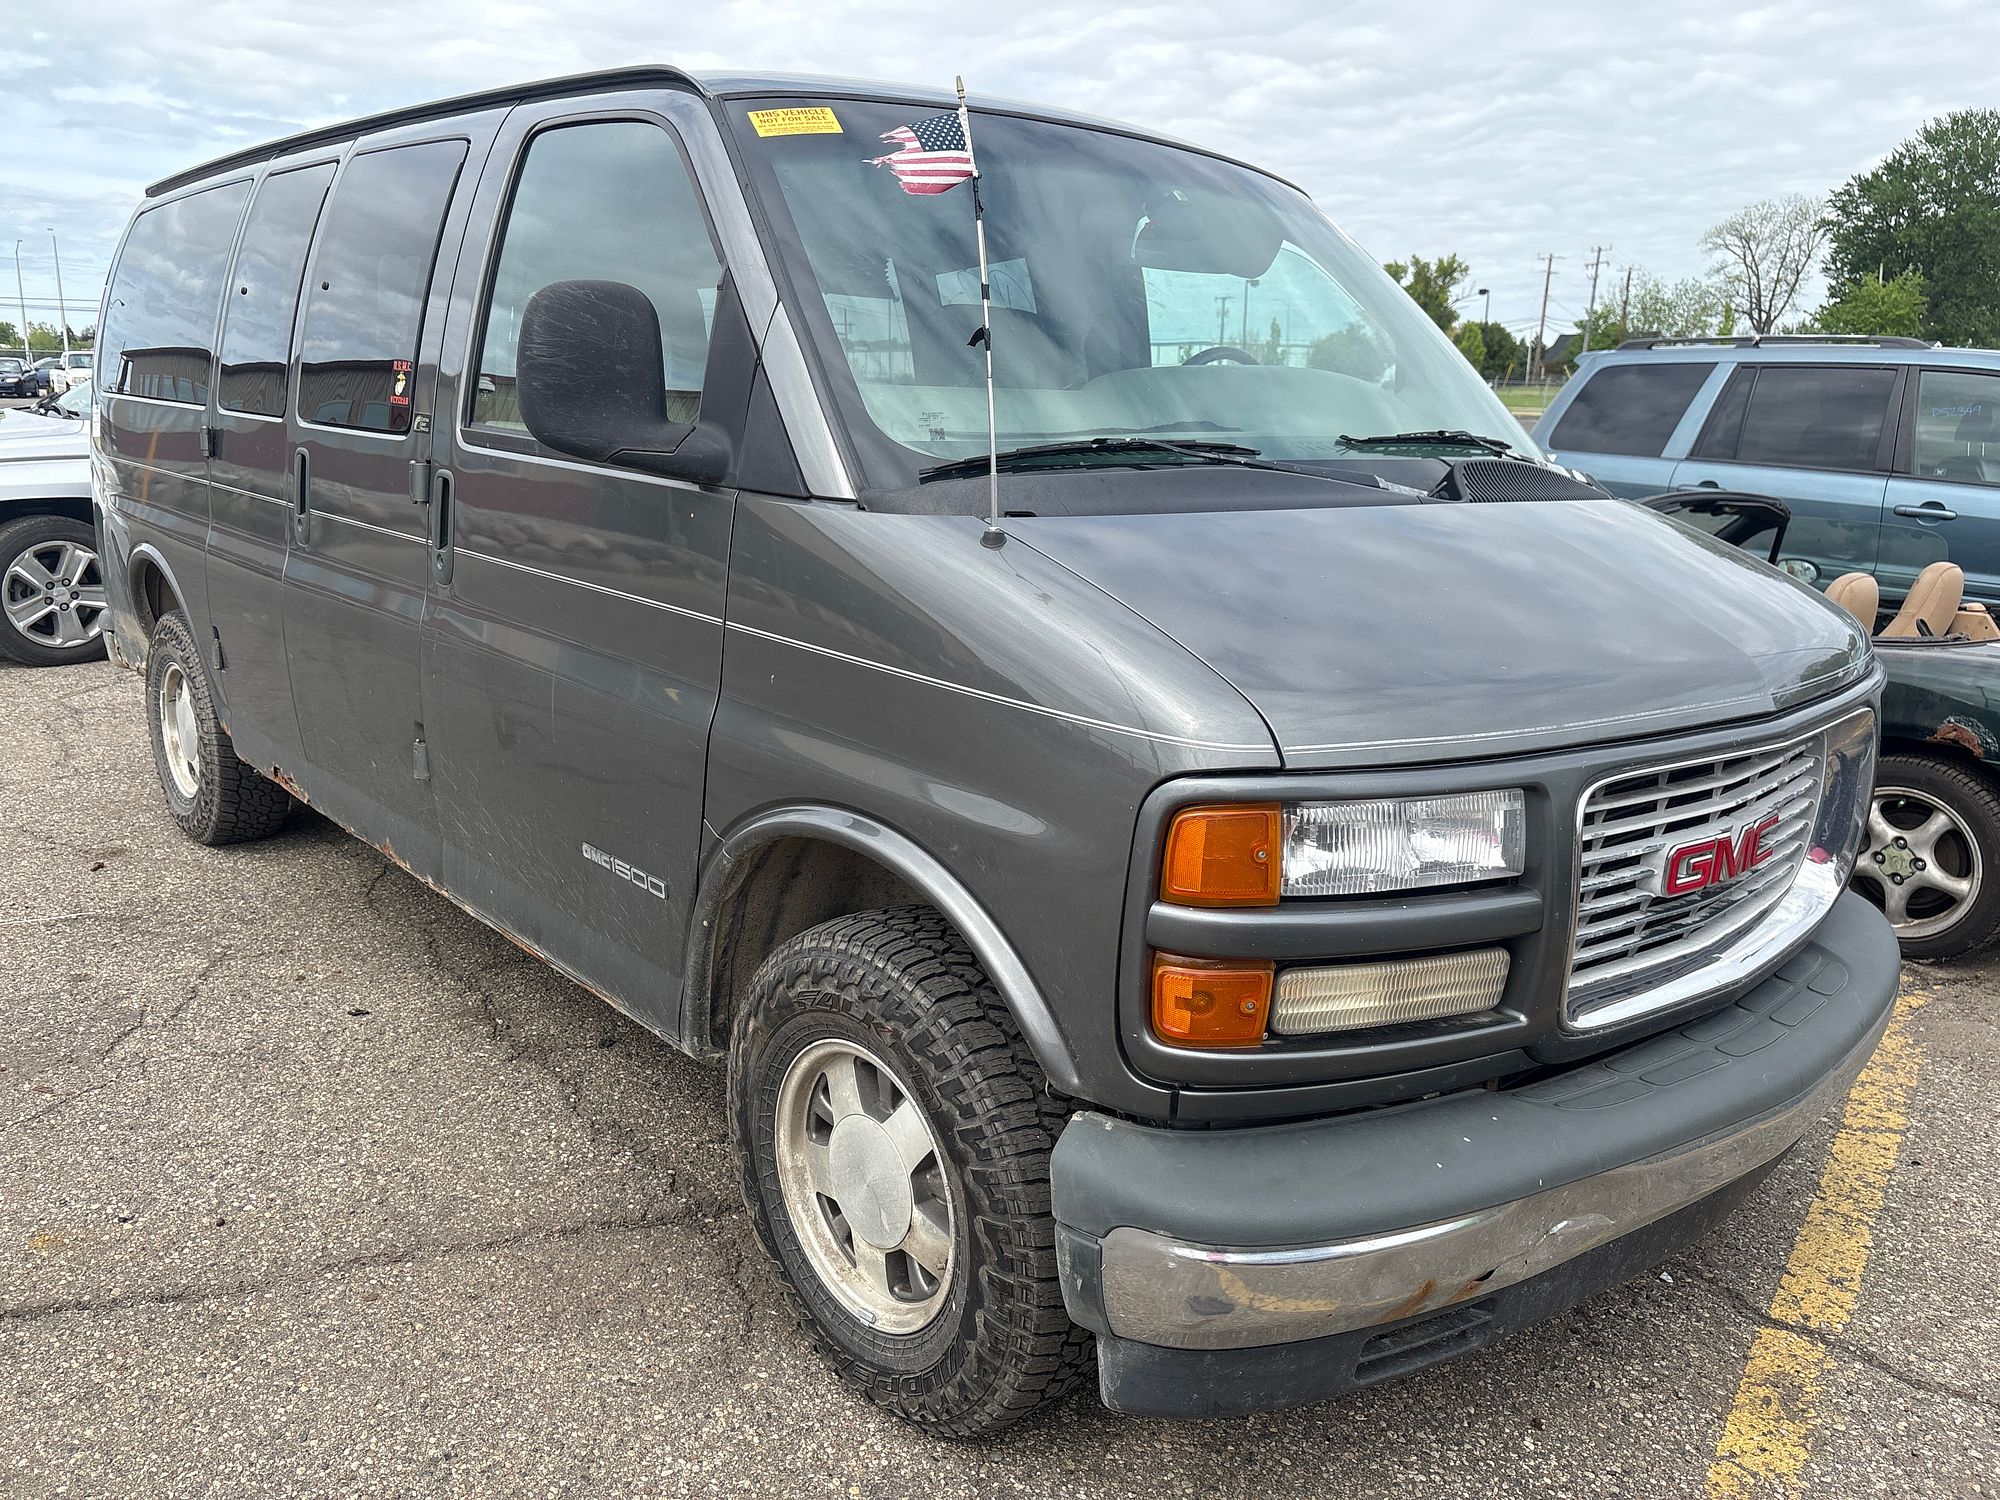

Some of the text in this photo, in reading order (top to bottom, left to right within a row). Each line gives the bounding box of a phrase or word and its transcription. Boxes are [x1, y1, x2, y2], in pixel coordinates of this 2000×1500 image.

[754, 108, 828, 119] THIS VEHICLE
[1664, 811, 1779, 897] GMC
